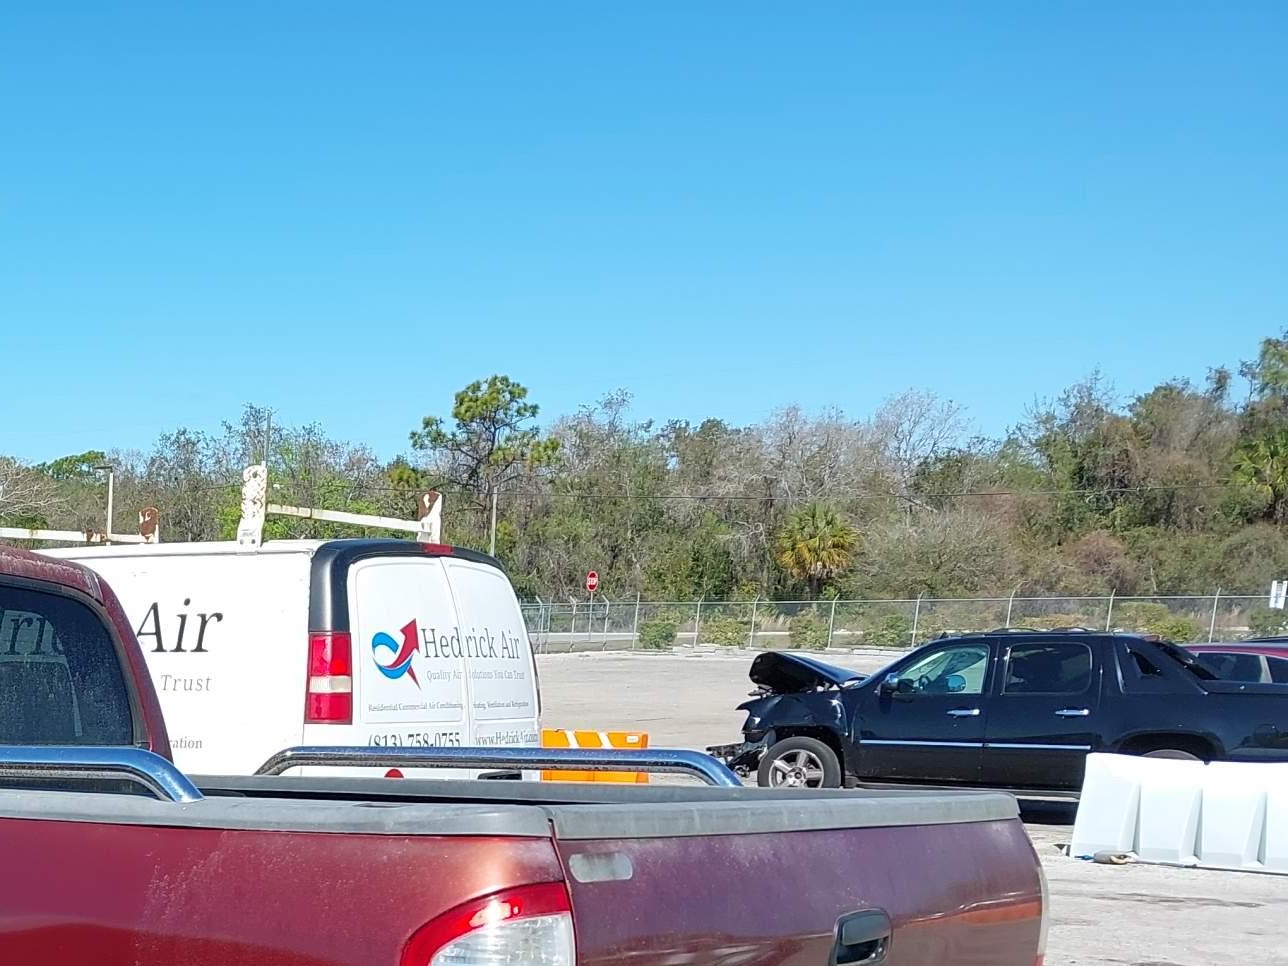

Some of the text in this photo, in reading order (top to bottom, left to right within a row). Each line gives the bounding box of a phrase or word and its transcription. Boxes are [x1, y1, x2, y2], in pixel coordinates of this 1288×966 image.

[136, 597, 224, 653] Air
[420, 626, 520, 659] Hedrick Air
[160, 674, 213, 692] Trust
[368, 733, 403, 747] (813)
